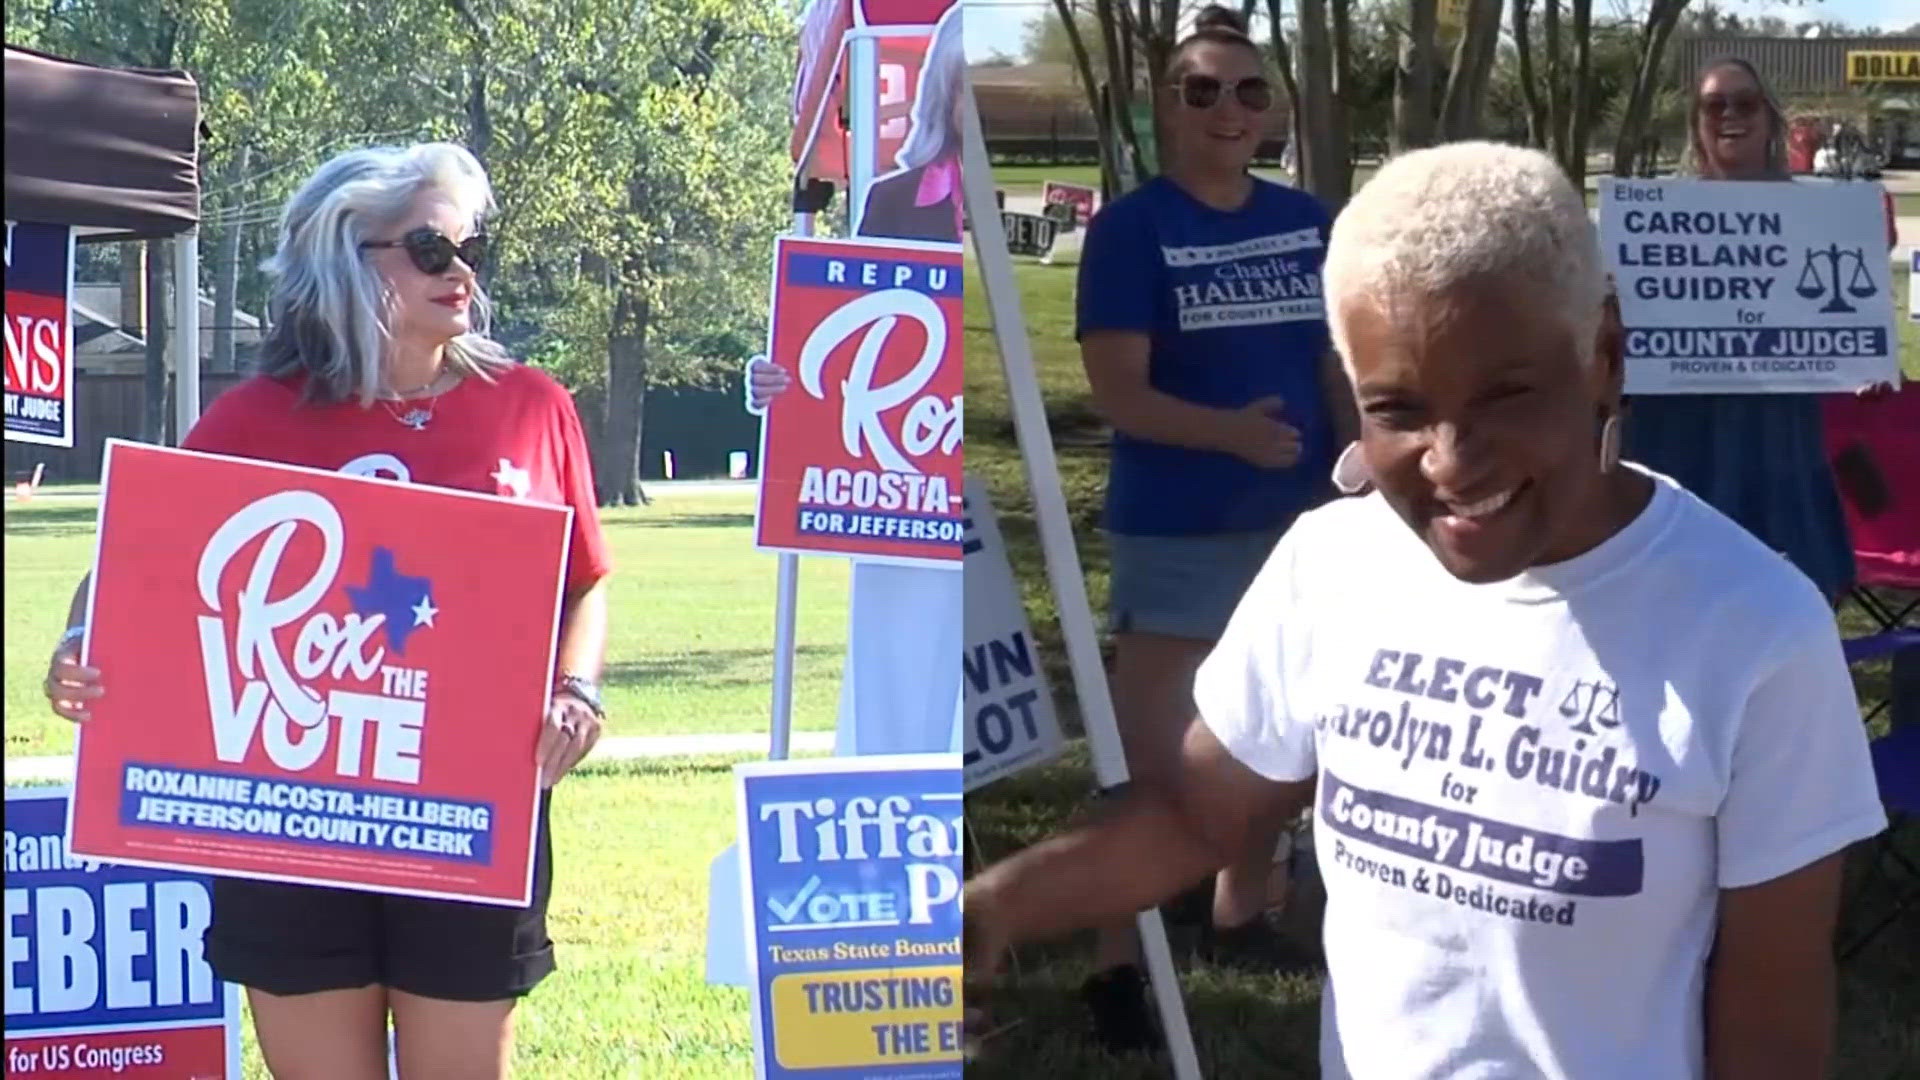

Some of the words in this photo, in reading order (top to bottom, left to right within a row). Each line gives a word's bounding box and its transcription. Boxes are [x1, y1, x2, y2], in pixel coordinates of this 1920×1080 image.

[1614, 184, 1663, 201] Elect
[1624, 210, 1781, 235] CAROLYN
[1214, 257, 1299, 279] Charlie
[1619, 243, 1788, 267] LEBLANC
[827, 260, 947, 290] REPU
[1635, 276, 1774, 300] GUIDRY
[1737, 308, 1766, 324] for
[1627, 330, 1760, 356] COUNTY
[1771, 330, 1877, 356] JUDGE
[1670, 360, 1732, 373] PROVEN
[1738, 361, 1746, 373] &
[1752, 360, 1836, 372] DEDICATED
[20, 396, 61, 422] JUDGE
[801, 512, 843, 533] FOR
[196, 489, 386, 729] Rox
[381, 665, 428, 698] THE
[1365, 648, 1544, 719] ELECT
[197, 615, 426, 785] VOTE
[1460, 715, 1495, 771] L.
[1506, 725, 1661, 818] Guidry
[126, 767, 252, 804] ROXANNE
[254, 781, 489, 831] ACOSTA-HELLBERG
[1441, 772, 1478, 804] for
[137, 797, 281, 836] JEFFERSON
[285, 817, 388, 848] COUNTY
[392, 830, 474, 857] CLERK
[1331, 786, 1459, 861] County
[1460, 822, 1589, 887] Judge
[1335, 839, 1406, 888] Proven
[1411, 867, 1430, 895] &
[1435, 874, 1577, 927] Dedicated
[768, 944, 830, 963] Texas
[833, 942, 889, 960] State
[895, 937, 960, 957] Board
[803, 976, 954, 1014] TRUSTING
[872, 1023, 930, 1055] THE
[9, 1047, 38, 1073] for
[43, 1046, 70, 1069] US
[74, 1044, 163, 1072] Congress
